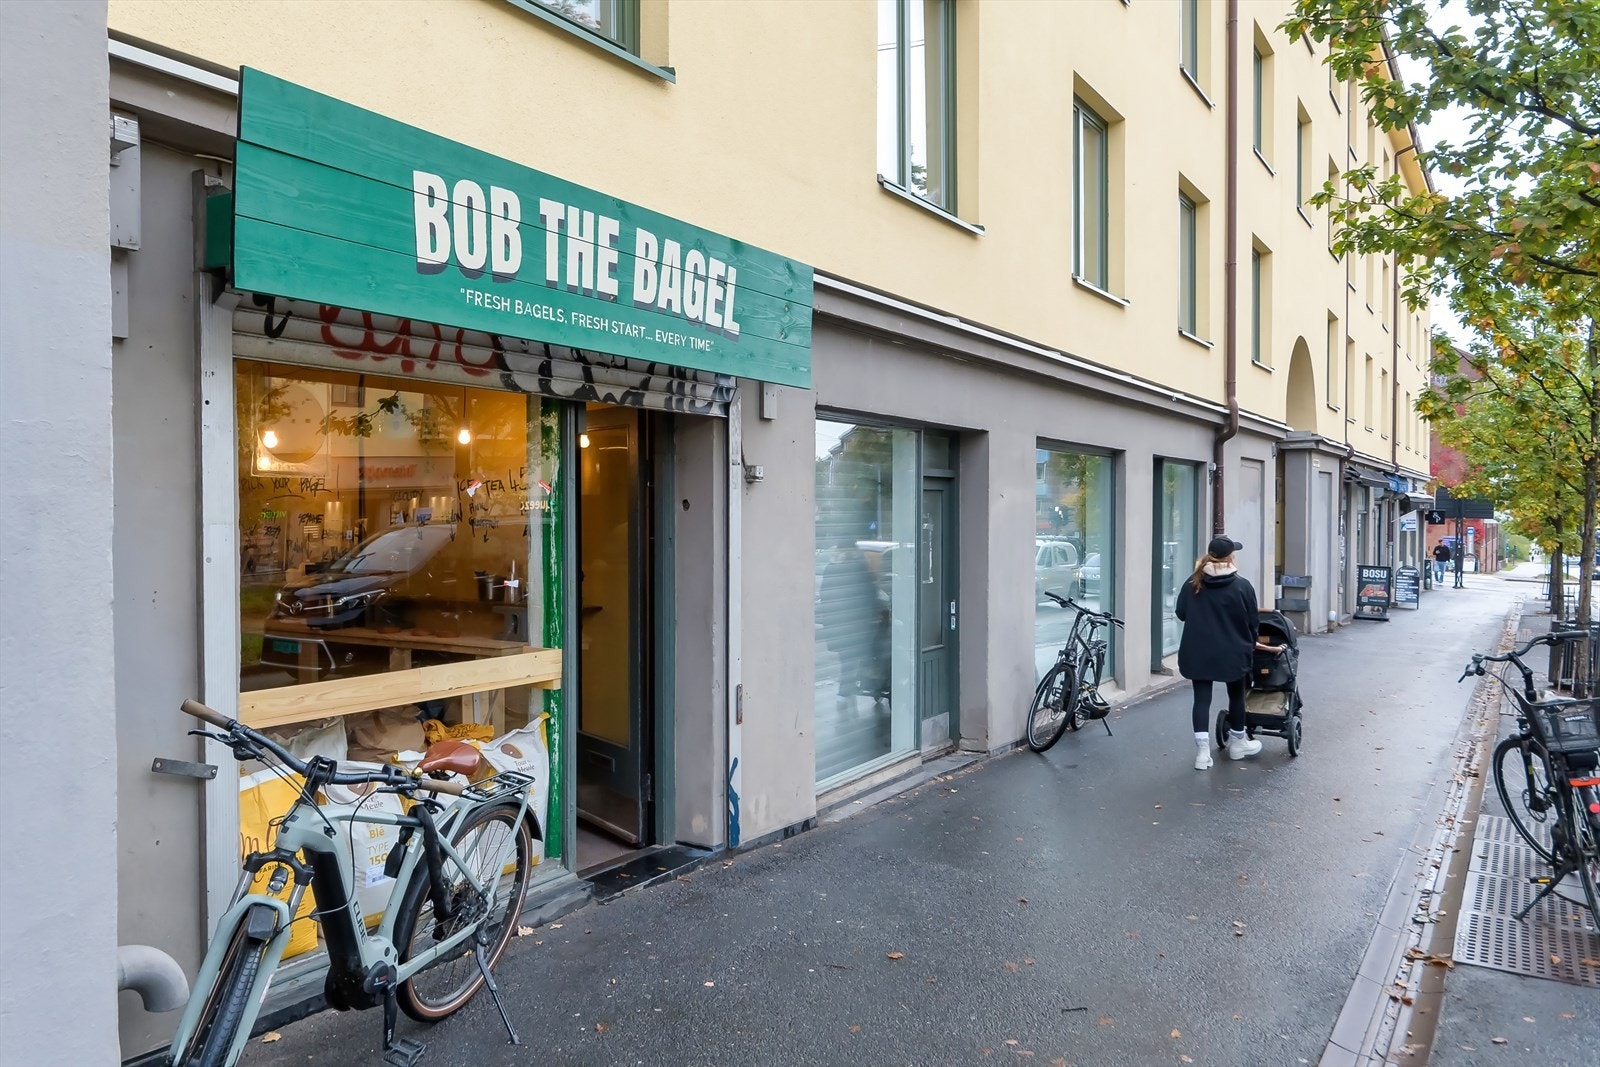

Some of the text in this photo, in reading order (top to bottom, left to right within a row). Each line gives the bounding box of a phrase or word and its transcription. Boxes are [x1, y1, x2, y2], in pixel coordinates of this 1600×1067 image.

[413, 170, 740, 338] BOB THE BAGEL
[571, 311, 609, 332] FRESH
[655, 329, 687, 347] EVERY
[1362, 569, 1387, 578] BOSU
[369, 825, 385, 840] Blé
[367, 841, 389, 856] TYPE
[353, 901, 368, 946] CUBE
